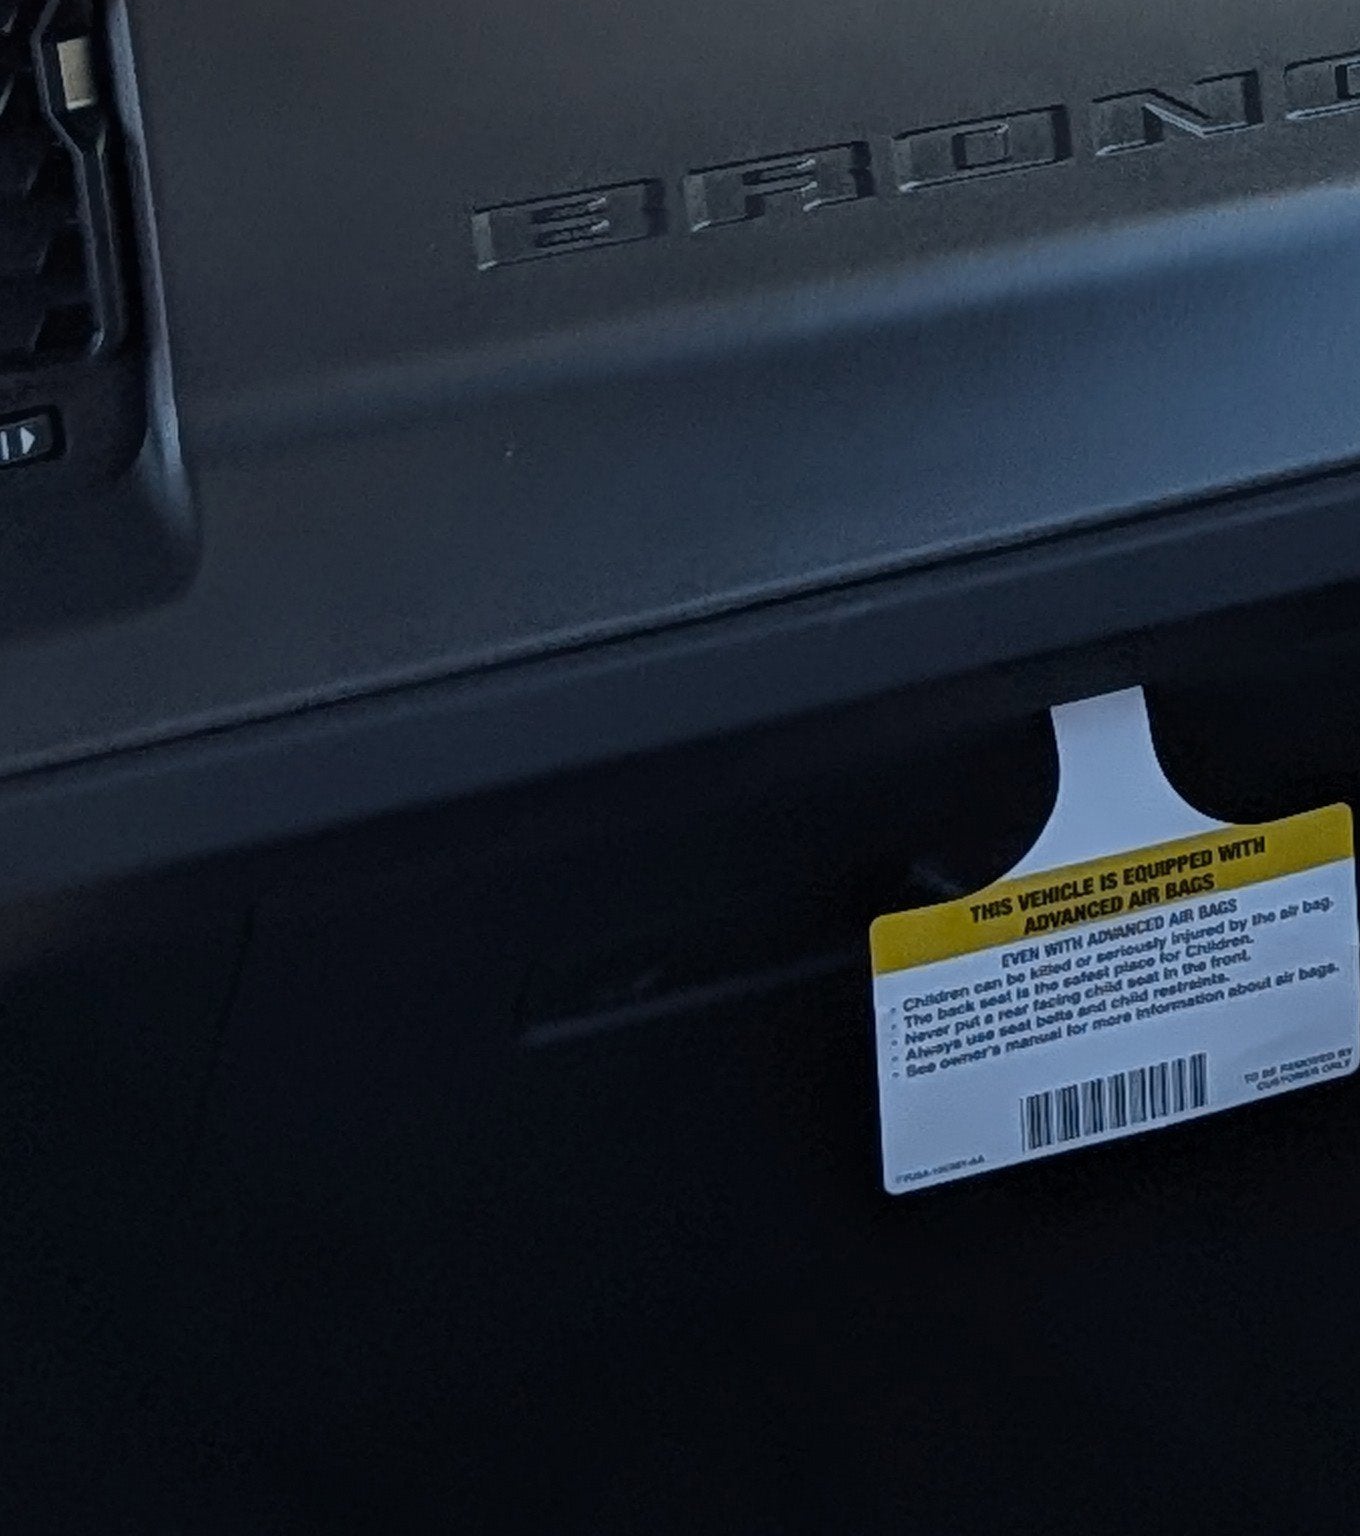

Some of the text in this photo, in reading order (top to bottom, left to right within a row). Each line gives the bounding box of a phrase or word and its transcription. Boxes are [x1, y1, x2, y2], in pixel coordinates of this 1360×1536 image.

[970, 836, 1265, 923] THIS VEHICLE IS EQUIPPED WITH
[1023, 873, 1215, 935] ADVANCED AIR BAGS
[903, 986, 969, 1013] Children
[974, 978, 1002, 995] can
[1006, 968, 1026, 986] be
[1030, 956, 1071, 980] killed
[1076, 954, 1092, 967] or
[1096, 934, 1167, 965] seriously
[1171, 919, 1225, 946] injured
[1229, 915, 1247, 935] by
[1252, 910, 1276, 927] the
[1280, 905, 1299, 920] air
[1002, 898, 1238, 969] EVEN WITH ADVANCED AIR BAGS
[903, 934, 1255, 1029] The back seat is the safest place for Children.
[904, 949, 1252, 1046] Never put a rear facing child seat in the front.
[905, 1061, 937, 1079] See
[939, 1044, 1001, 1071] owner's
[1005, 1026, 1062, 1054] manual
[1066, 1021, 1088, 1038] for
[1091, 1012, 1132, 1031] more
[1135, 990, 1226, 1021] information
[1227, 976, 1272, 999] about
[1275, 970, 1295, 987] air
[905, 1038, 963, 1063] Always
[966, 1028, 995, 1047] use
[1000, 1020, 1033, 1039] seat
[1035, 1007, 1074, 1028] belts
[1077, 1000, 1107, 1018] and
[1110, 987, 1149, 1009] child
